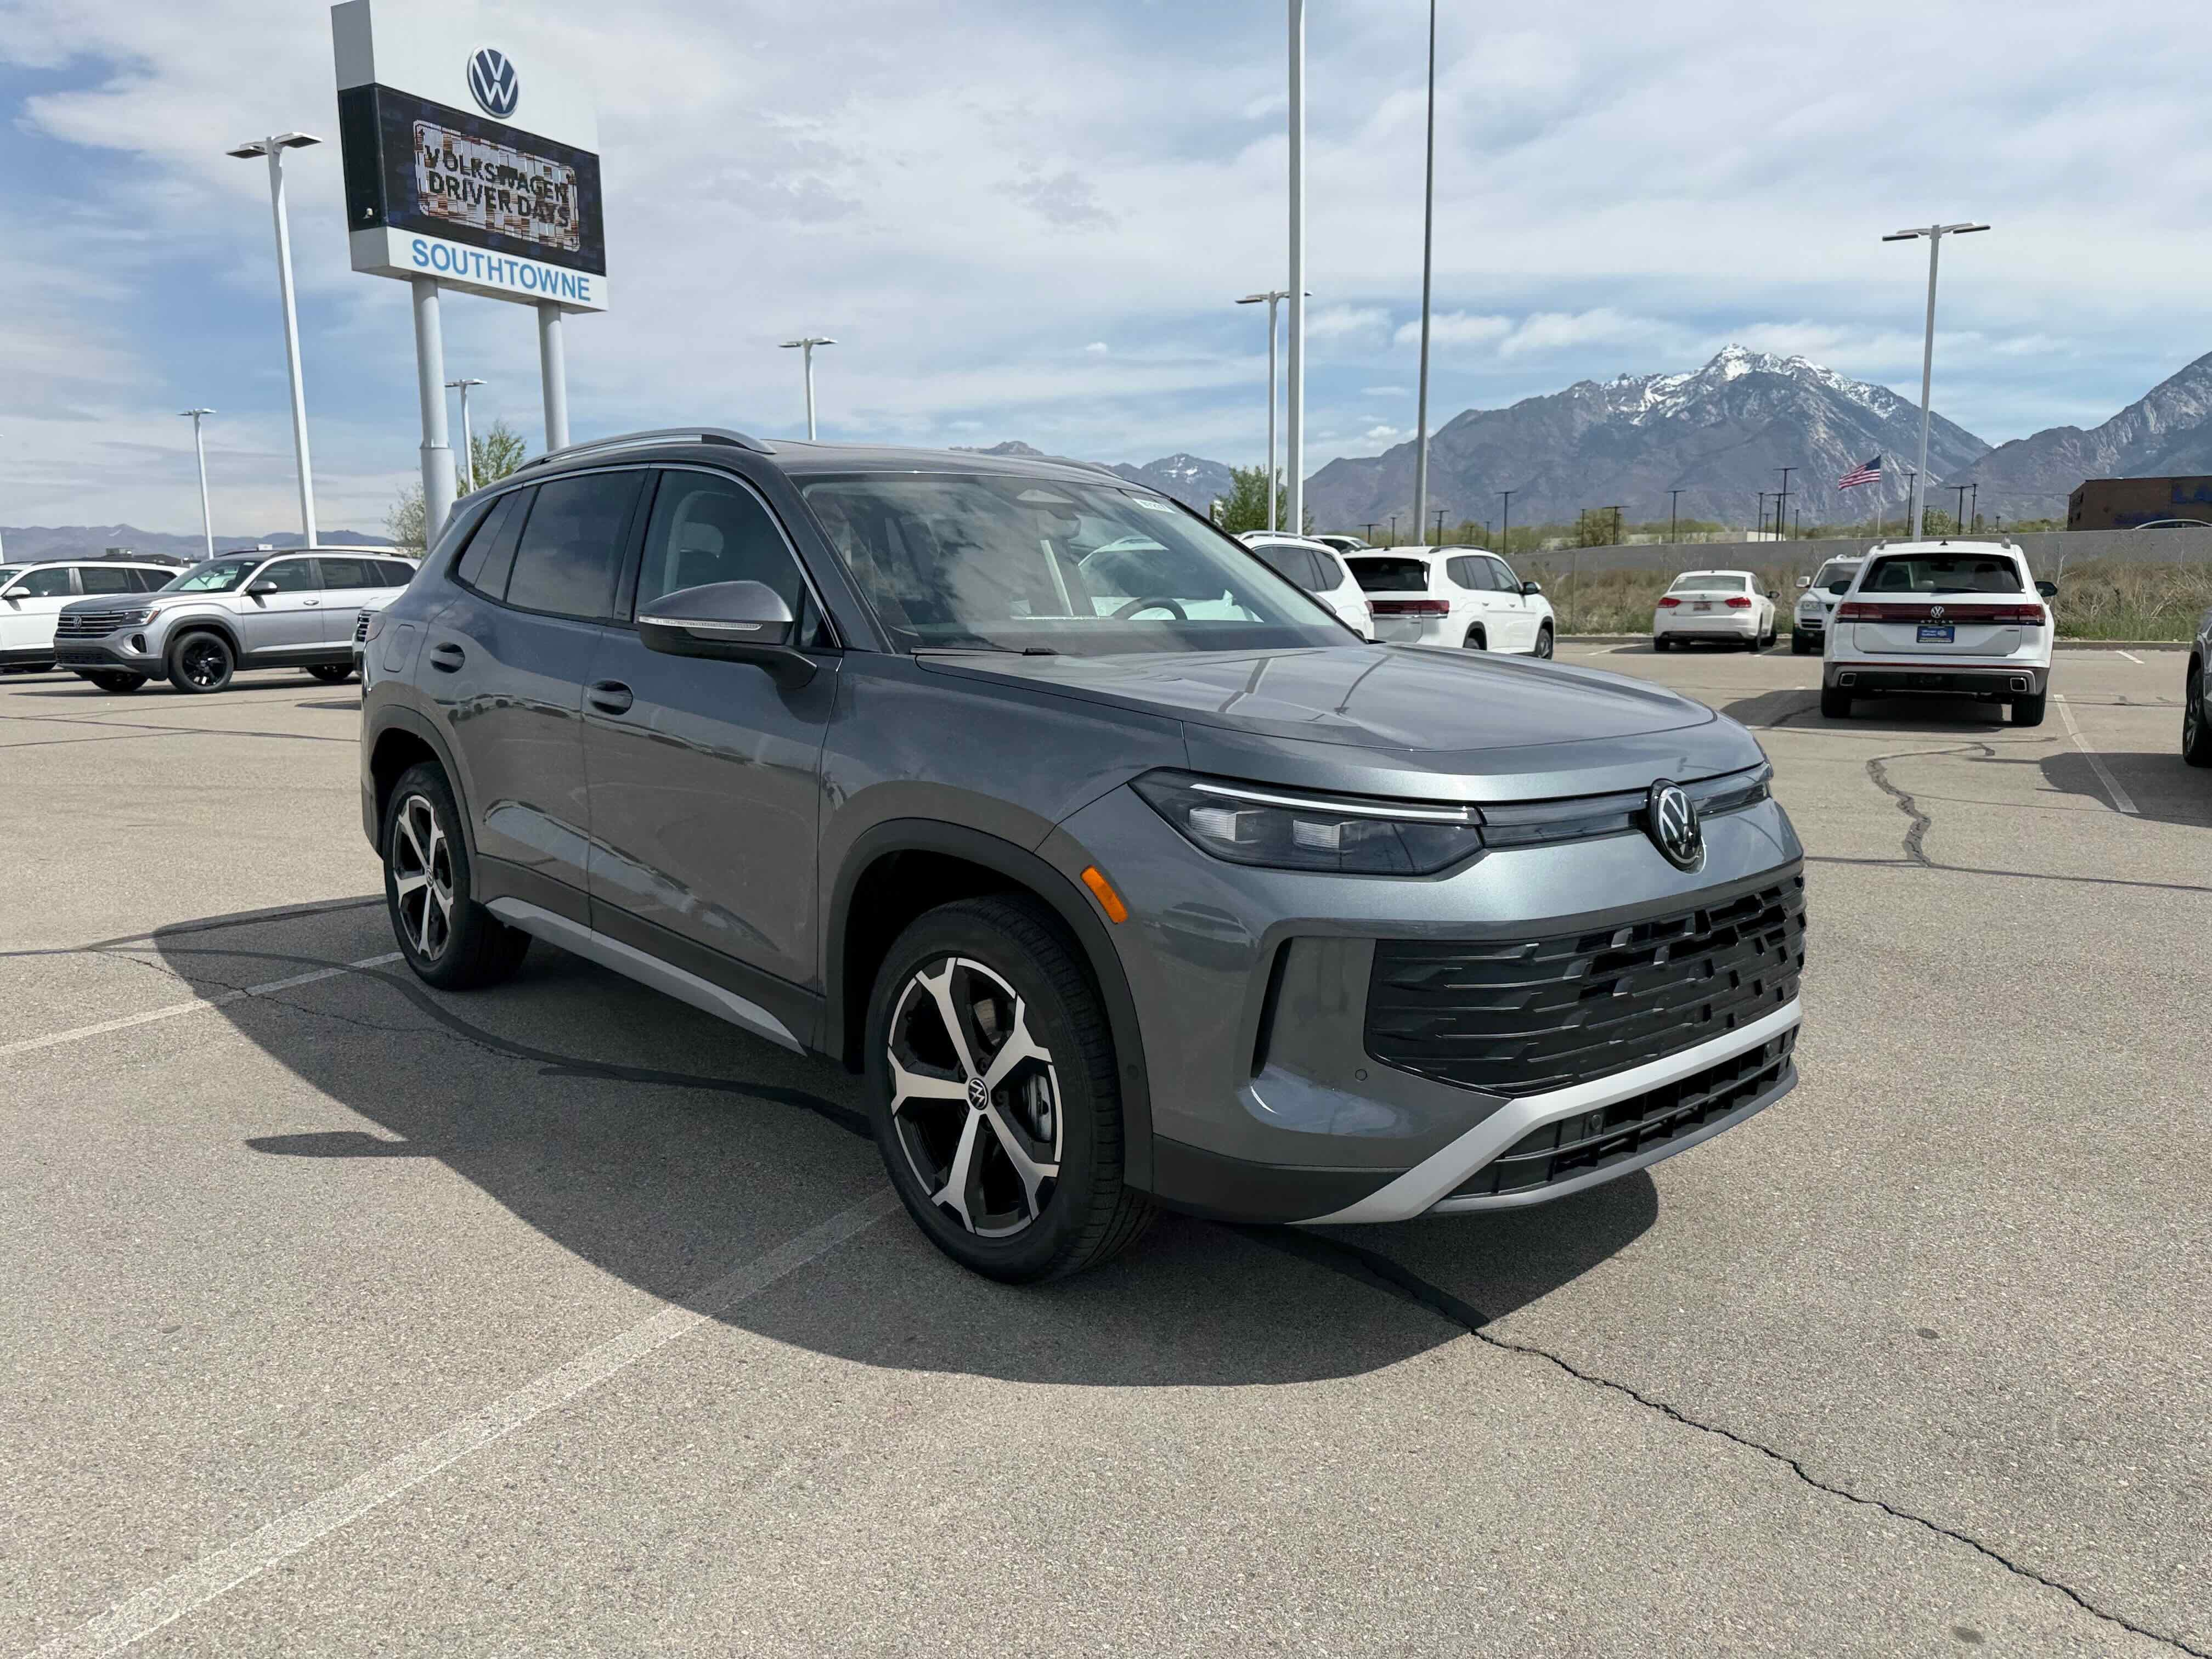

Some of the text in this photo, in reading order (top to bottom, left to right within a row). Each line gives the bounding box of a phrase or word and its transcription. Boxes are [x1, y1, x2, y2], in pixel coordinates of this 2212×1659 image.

[468, 46, 518, 119] VW
[424, 145, 568, 204] VOLKSWAGEN
[429, 171, 569, 228] DRIVER DAYS
[413, 239, 591, 302] SOUTHTOWNE
